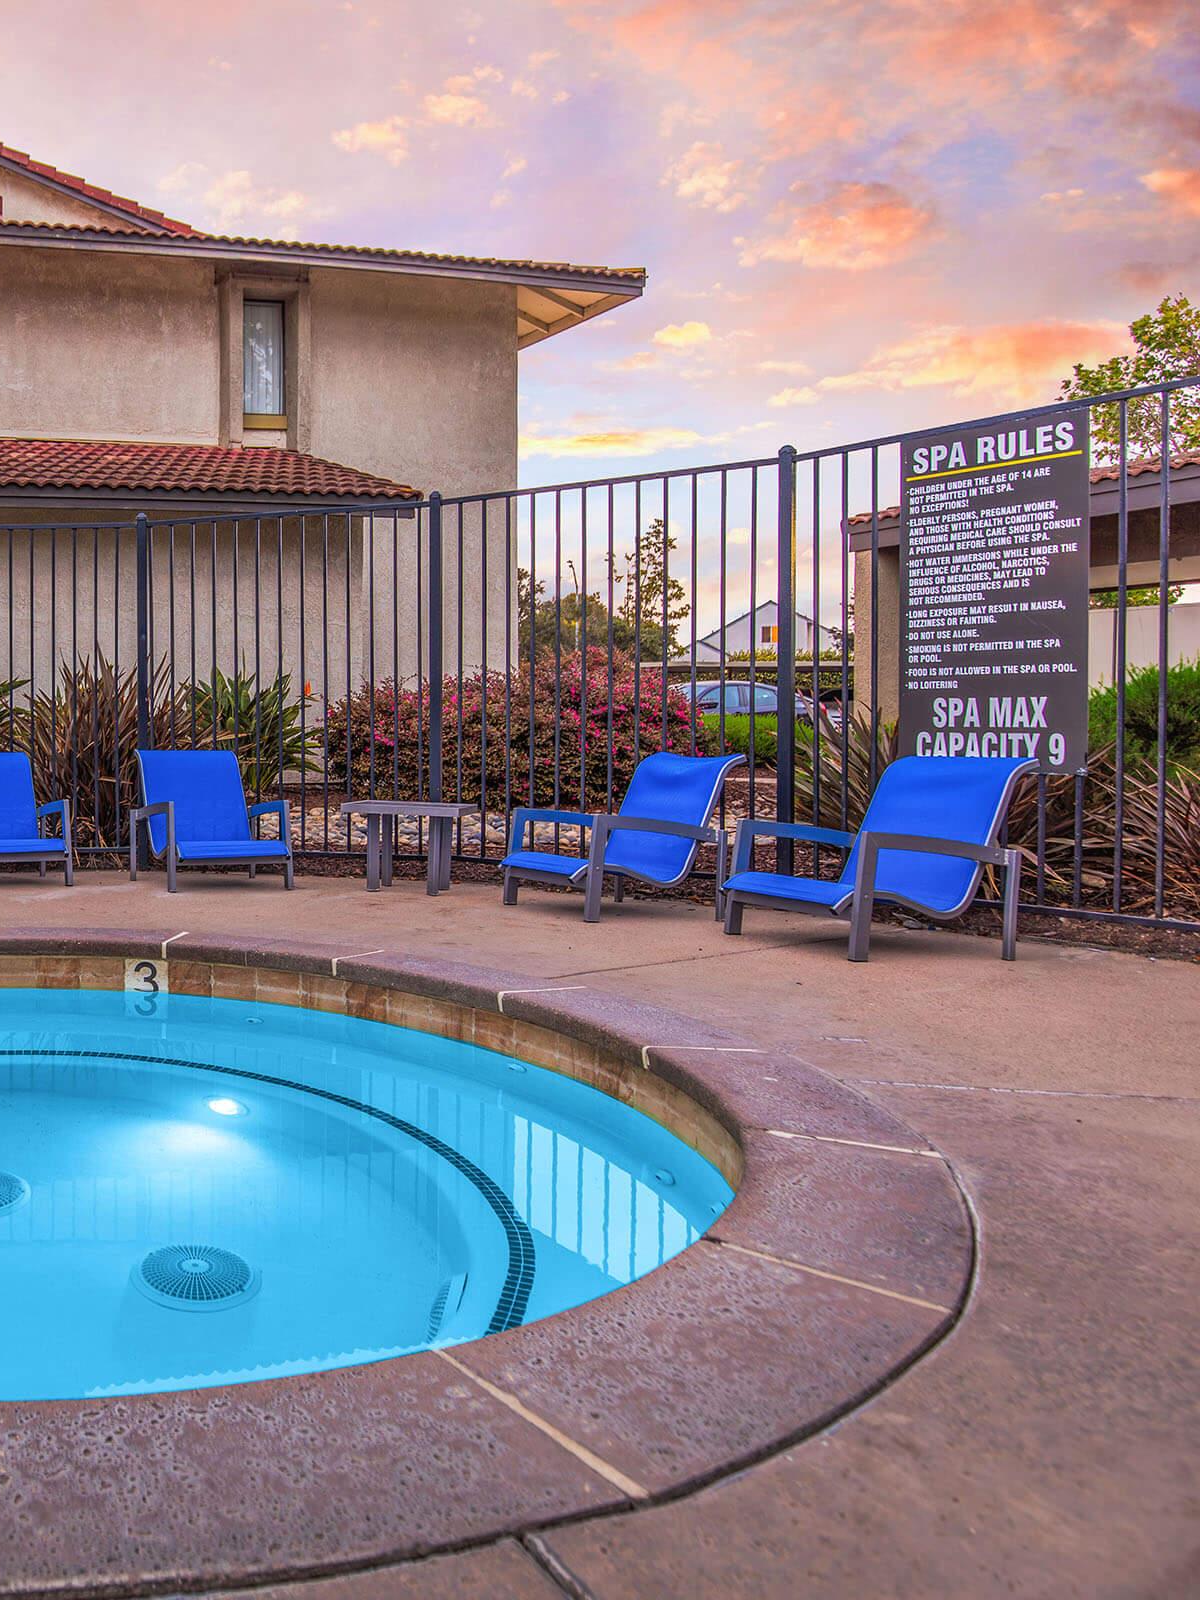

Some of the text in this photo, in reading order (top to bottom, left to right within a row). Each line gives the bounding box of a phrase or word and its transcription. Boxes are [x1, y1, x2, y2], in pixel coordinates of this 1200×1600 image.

[913, 422, 1074, 474] SPA RULES
[910, 467, 1051, 496] CHILDREN UNDER THE AGE OF 14 ARE
[910, 483, 1014, 505] NOT PERMITTED IN THE SPA.
[910, 499, 969, 515] NO EXCEPTIONS!
[910, 515, 940, 527] ELDERLY
[980, 505, 1022, 518] PREGNANT
[1024, 500, 1059, 512] WOMEN,
[909, 511, 1054, 536] AND THOSE WITH HEALTH CONDITIONS
[909, 518, 1082, 546] REQUIRING MEDICAL CARE SHOULD CONSULT
[909, 532, 1050, 555] A PHYSICIAN BEFORE USING THE SPA.
[909, 542, 1078, 568] HOT WATER IMMERSIONS WHILE UNDER THE
[909, 566, 949, 578] INFLUENCE
[950, 565, 961, 573] OF
[1001, 556, 1050, 569] NARCOTICS,
[909, 576, 933, 587] DRUGS
[935, 576, 946, 584] OR
[993, 570, 1011, 579] MAY
[1012, 568, 1033, 578] LEAD
[1035, 566, 1046, 576] TO
[909, 578, 1030, 596] SERIOUS CONSEQUENCES AND IS
[909, 592, 985, 606] NOT RECOMMENDED.
[909, 610, 928, 619] LONG
[929, 607, 968, 618] EXPOSURE
[969, 606, 987, 615] MAY
[1020, 602, 1029, 612] IN
[1030, 600, 1066, 610] NAUSEA,
[908, 615, 997, 628] DIZZINESS OR FAINTING.
[908, 629, 980, 640] DO NOT USE ALONE.
[908, 639, 1061, 654] SMOKING IS NOT PERMITTED IN THE SPA
[908, 654, 942, 664] OR POOL.
[908, 663, 1077, 677] FOOD IS NOT ALLOWED IN THE SPA OR POOL.
[908, 680, 958, 689] NO LOITERING
[933, 696, 1048, 728] SPA MAX
[916, 732, 1065, 766] CAPACITY 9
[134, 961, 159, 992] 3
